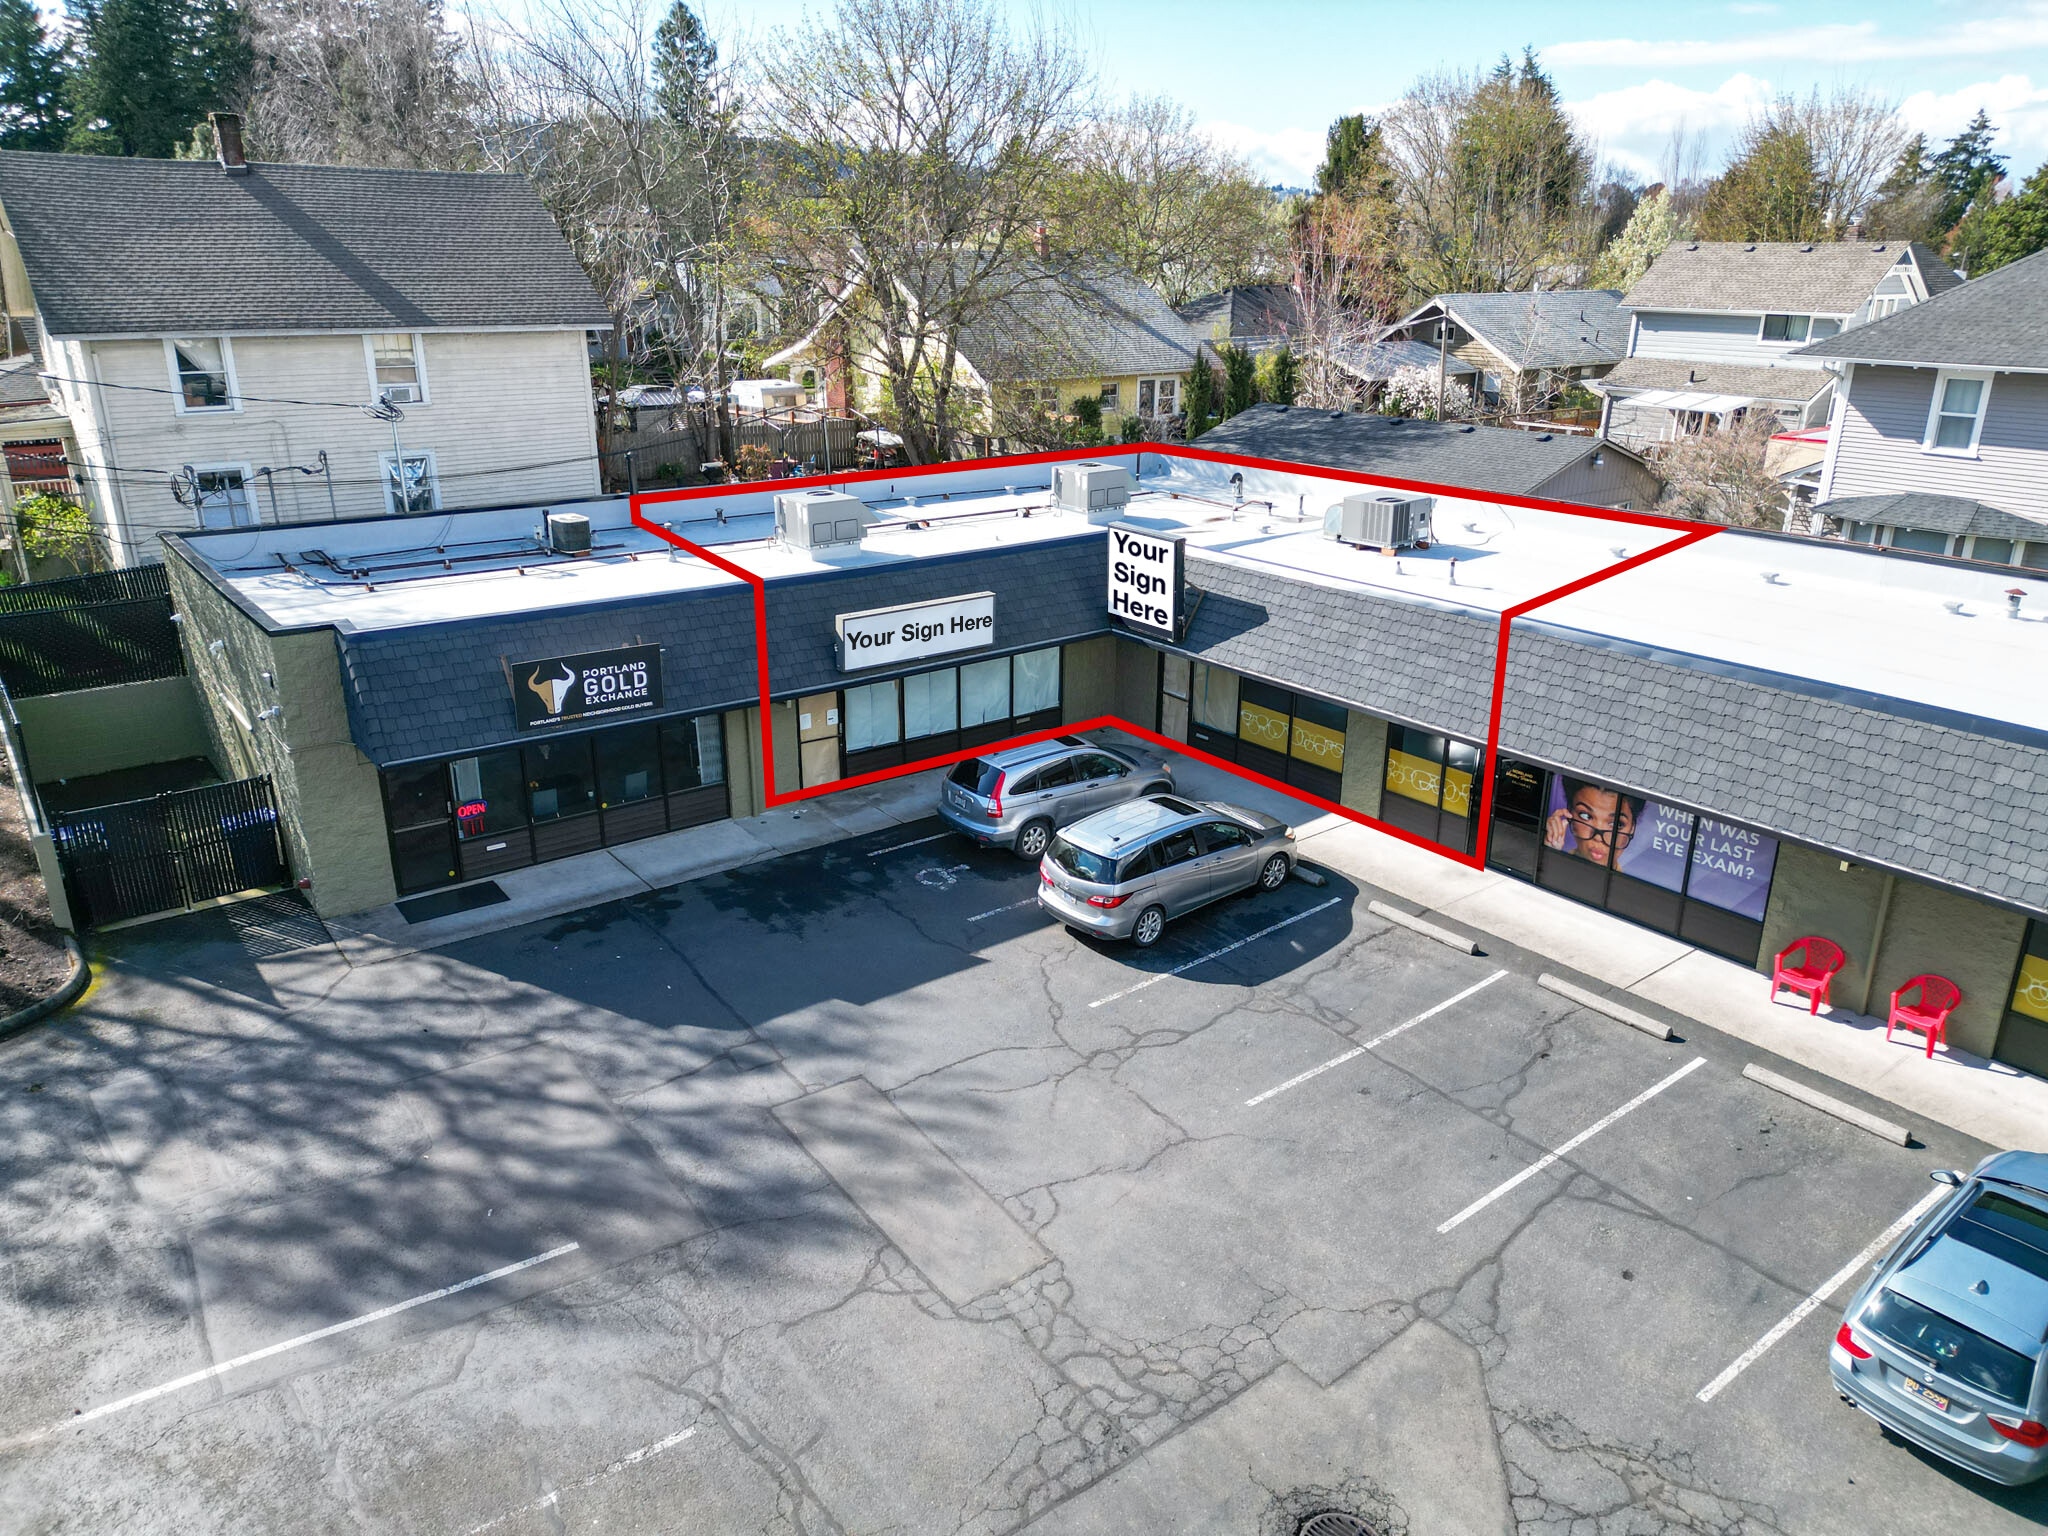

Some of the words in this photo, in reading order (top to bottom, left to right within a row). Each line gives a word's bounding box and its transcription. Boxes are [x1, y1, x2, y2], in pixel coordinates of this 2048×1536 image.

[1114, 531, 1168, 563] Your
[1114, 562, 1166, 595] Sign
[1113, 589, 1168, 625] Here
[847, 630, 895, 650] Your
[902, 622, 944, 642] Sign
[950, 615, 993, 634] Here
[582, 661, 646, 678] PORTLAND
[583, 671, 648, 696] GOLD
[561, 713, 583, 721] TRUSTED
[634, 701, 654, 709] BUYERS
[585, 688, 648, 705] EXCHANGE
[457, 802, 486, 817] OPEN
[1659, 804, 1713, 832] WHEN
[1720, 823, 1760, 846] WAS
[1656, 820, 1705, 847] YOUR
[1710, 838, 1755, 861] LAST
[1653, 836, 1684, 857] EYE
[1692, 850, 1755, 880] EXAM?
